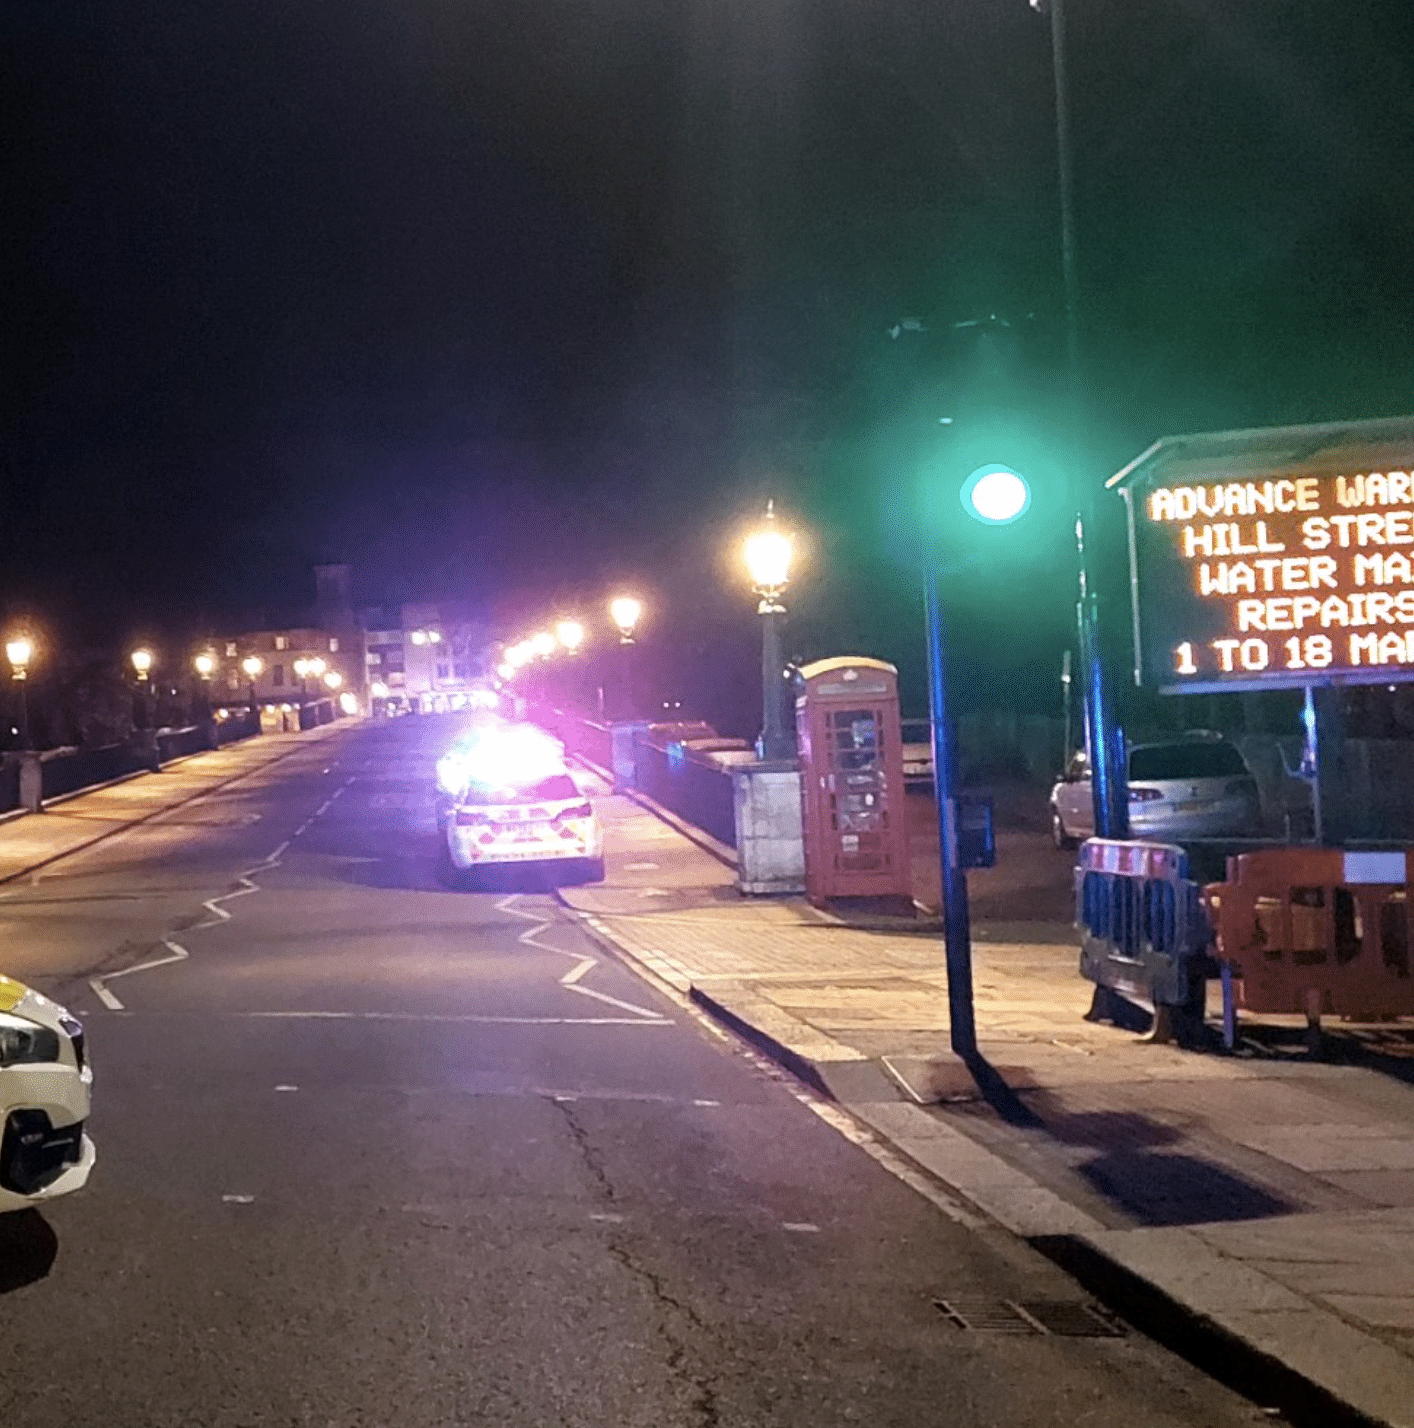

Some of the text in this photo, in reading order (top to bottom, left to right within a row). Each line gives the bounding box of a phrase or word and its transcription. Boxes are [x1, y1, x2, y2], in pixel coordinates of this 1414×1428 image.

[1151, 471, 1414, 521] ADVANCE WAR
[1184, 511, 1414, 557] HILL STRE
[1200, 551, 1414, 595] WATER MA
[1238, 590, 1414, 632] REPAIRS
[1176, 641, 1197, 674] 1
[1213, 638, 1269, 672] TO
[1285, 634, 1332, 669] 18
